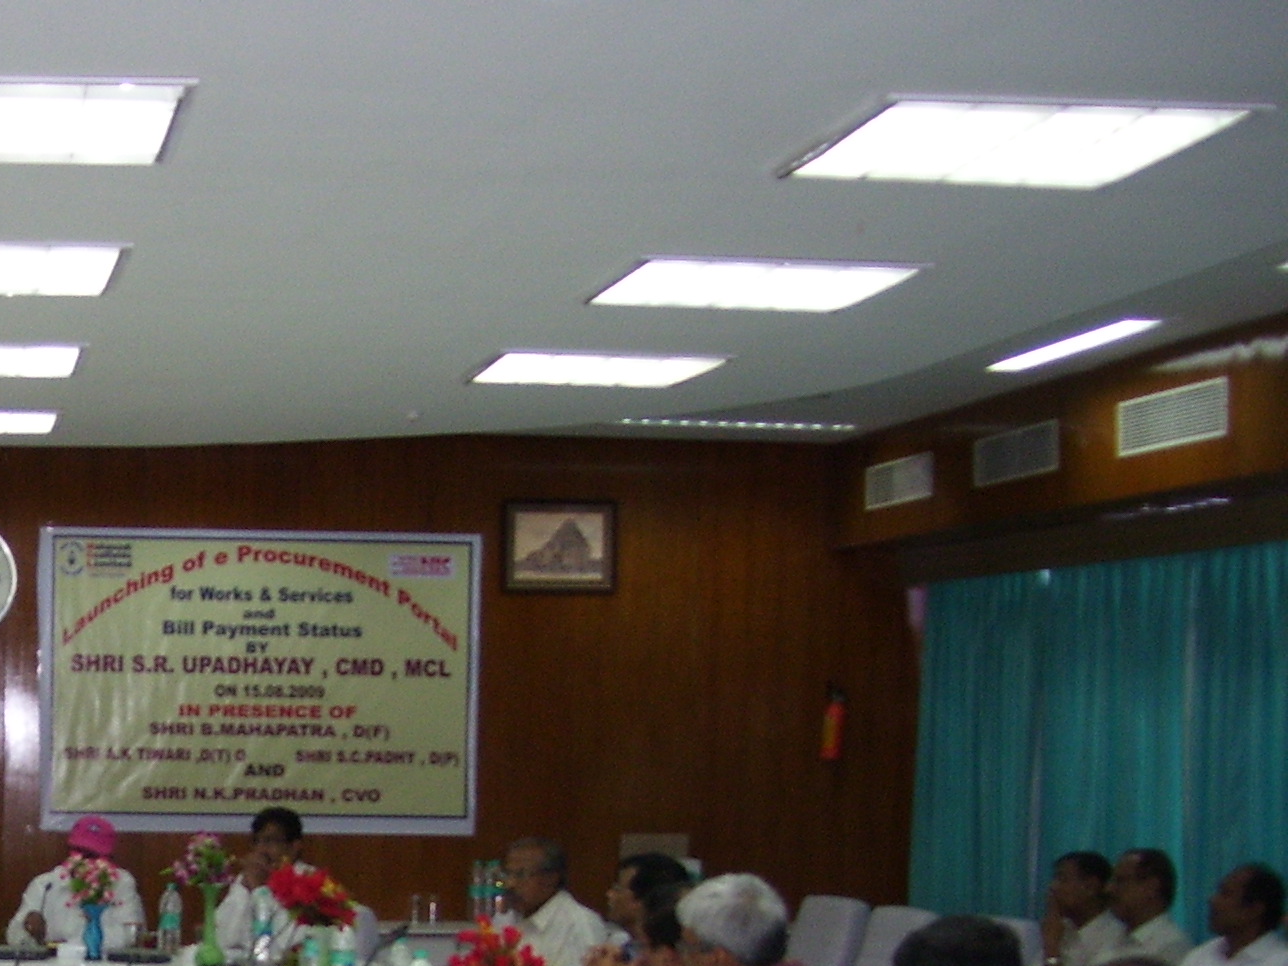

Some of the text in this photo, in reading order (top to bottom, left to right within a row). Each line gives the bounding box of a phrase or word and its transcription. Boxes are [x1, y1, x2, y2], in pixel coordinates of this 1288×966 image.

[63, 545, 459, 652] Launching of e Procurement Portal
[170, 585, 354, 603] for Works & Services
[243, 609, 276, 619] and
[163, 620, 363, 640] Bill Payment Status
[245, 641, 268, 653] BY
[70, 653, 124, 673] SHRI
[132, 655, 175, 673] S.R.
[182, 655, 315, 675] UPADHAYAY
[335, 657, 385, 677] CMD
[404, 659, 452, 678] MCL
[214, 684, 237, 697] ON
[178, 703, 358, 719] IN PRESENCE OF
[149, 721, 195, 736] SHRI
[244, 763, 286, 777] AND
[142, 786, 188, 800] SHRI
[341, 788, 382, 803] CVO
